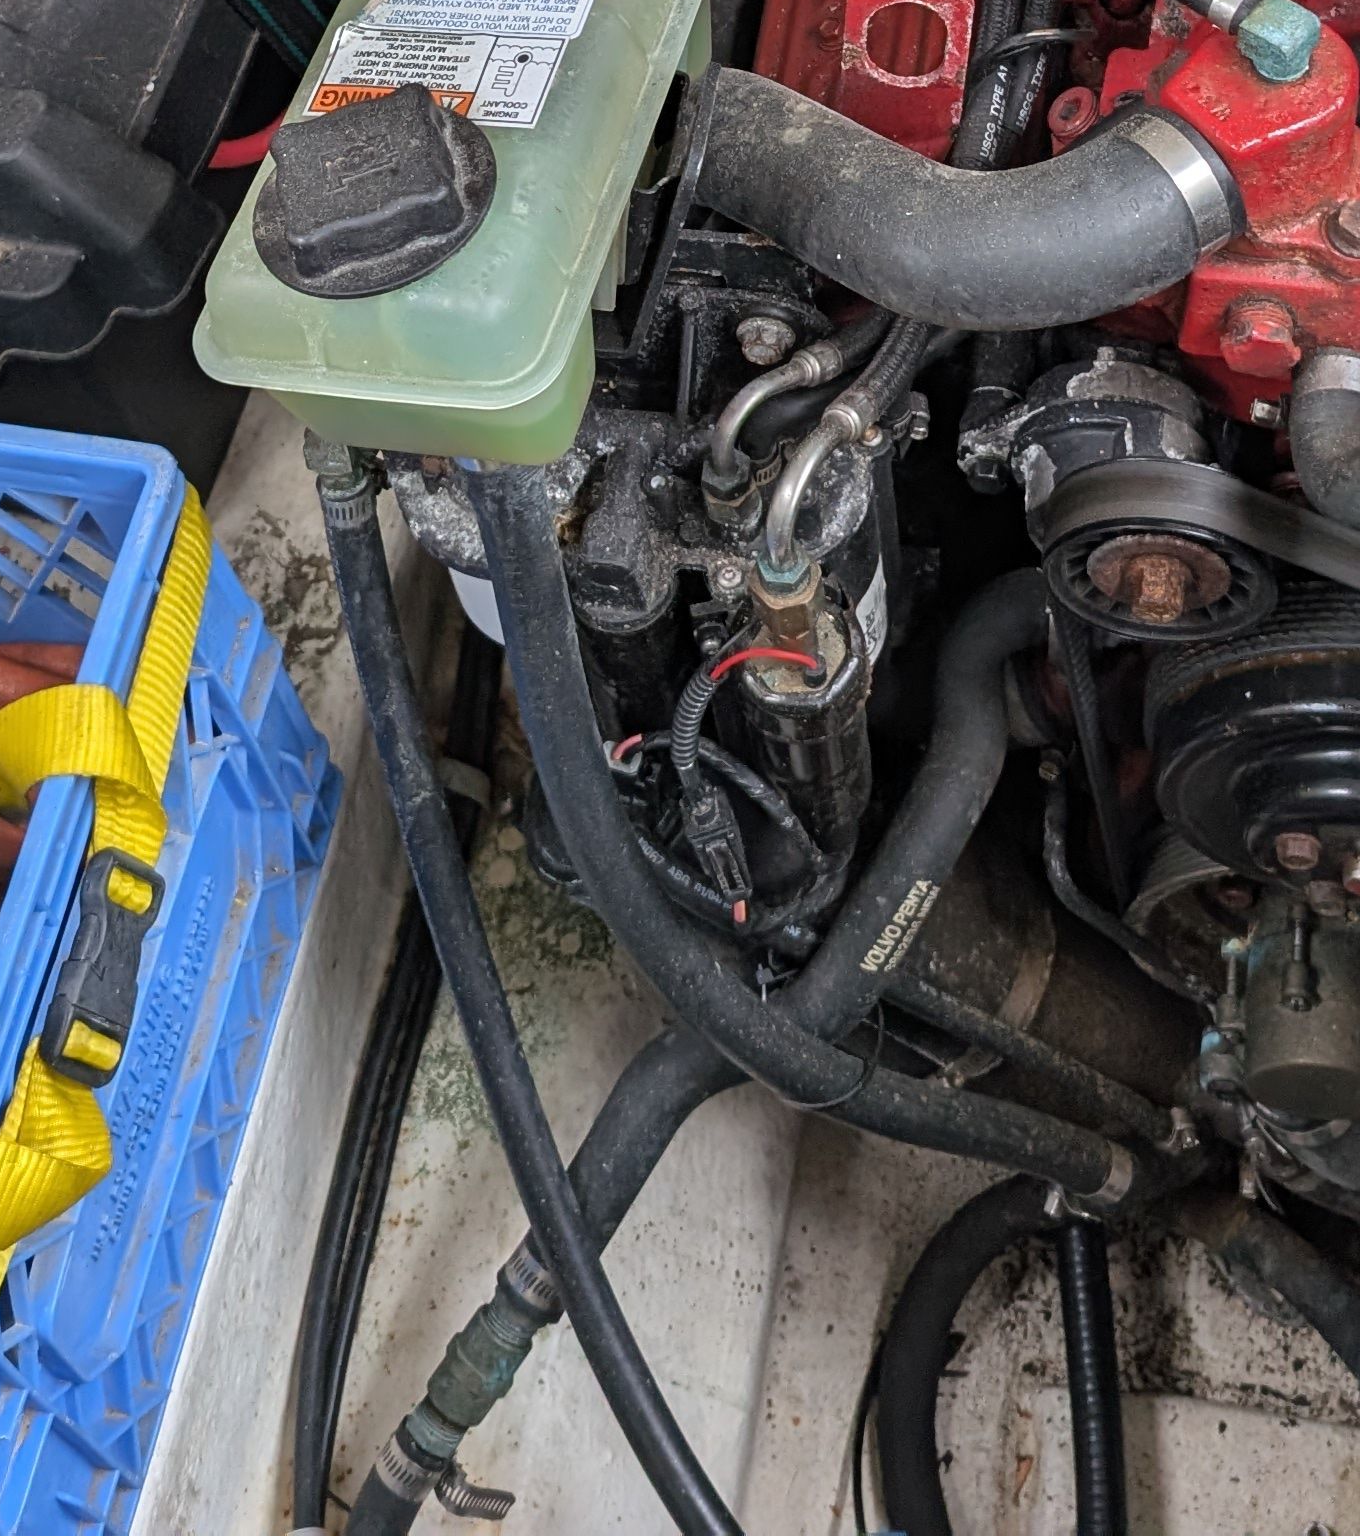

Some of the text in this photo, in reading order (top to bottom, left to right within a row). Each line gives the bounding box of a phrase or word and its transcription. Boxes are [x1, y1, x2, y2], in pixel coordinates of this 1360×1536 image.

[464, 1, 495, 10] VOLVO
[498, 3, 521, 11] MED
[525, 3, 576, 13] EFTERFYLL
[448, 12, 482, 21] OTHER
[484, 14, 509, 23] WITH
[513, 15, 531, 23] MIX
[533, 16, 554, 24] NOT
[555, 17, 572, 25] DO
[471, 21, 502, 30] VOLVO
[505, 23, 530, 32] WITH
[532, 24, 547, 32] UP
[548, 25, 568, 33] TOP
[386, 43, 447, 53] MAY ESCAPE.
[352, 50, 399, 60] COOLANT
[400, 53, 420, 61] HOT
[437, 54, 470, 62] STEAM
[392, 62, 428, 70] ENGINE
[430, 64, 458, 72] WHEN
[375, 69, 408, 77] FILLER
[408, 71, 456, 81] COOLANT
[997, 64, 1008, 83] A1
[377, 78, 394, 86] THE
[426, 81, 445, 89] NOT
[447, 83, 461, 91] DO
[480, 100, 528, 109] COOLANT
[990, 84, 1005, 117] TYPE
[1016, 91, 1034, 127] USCG
[482, 109, 519, 119] ENGINE
[980, 122, 996, 159] USCG
[860, 880, 933, 972] VOLVO PENTA
